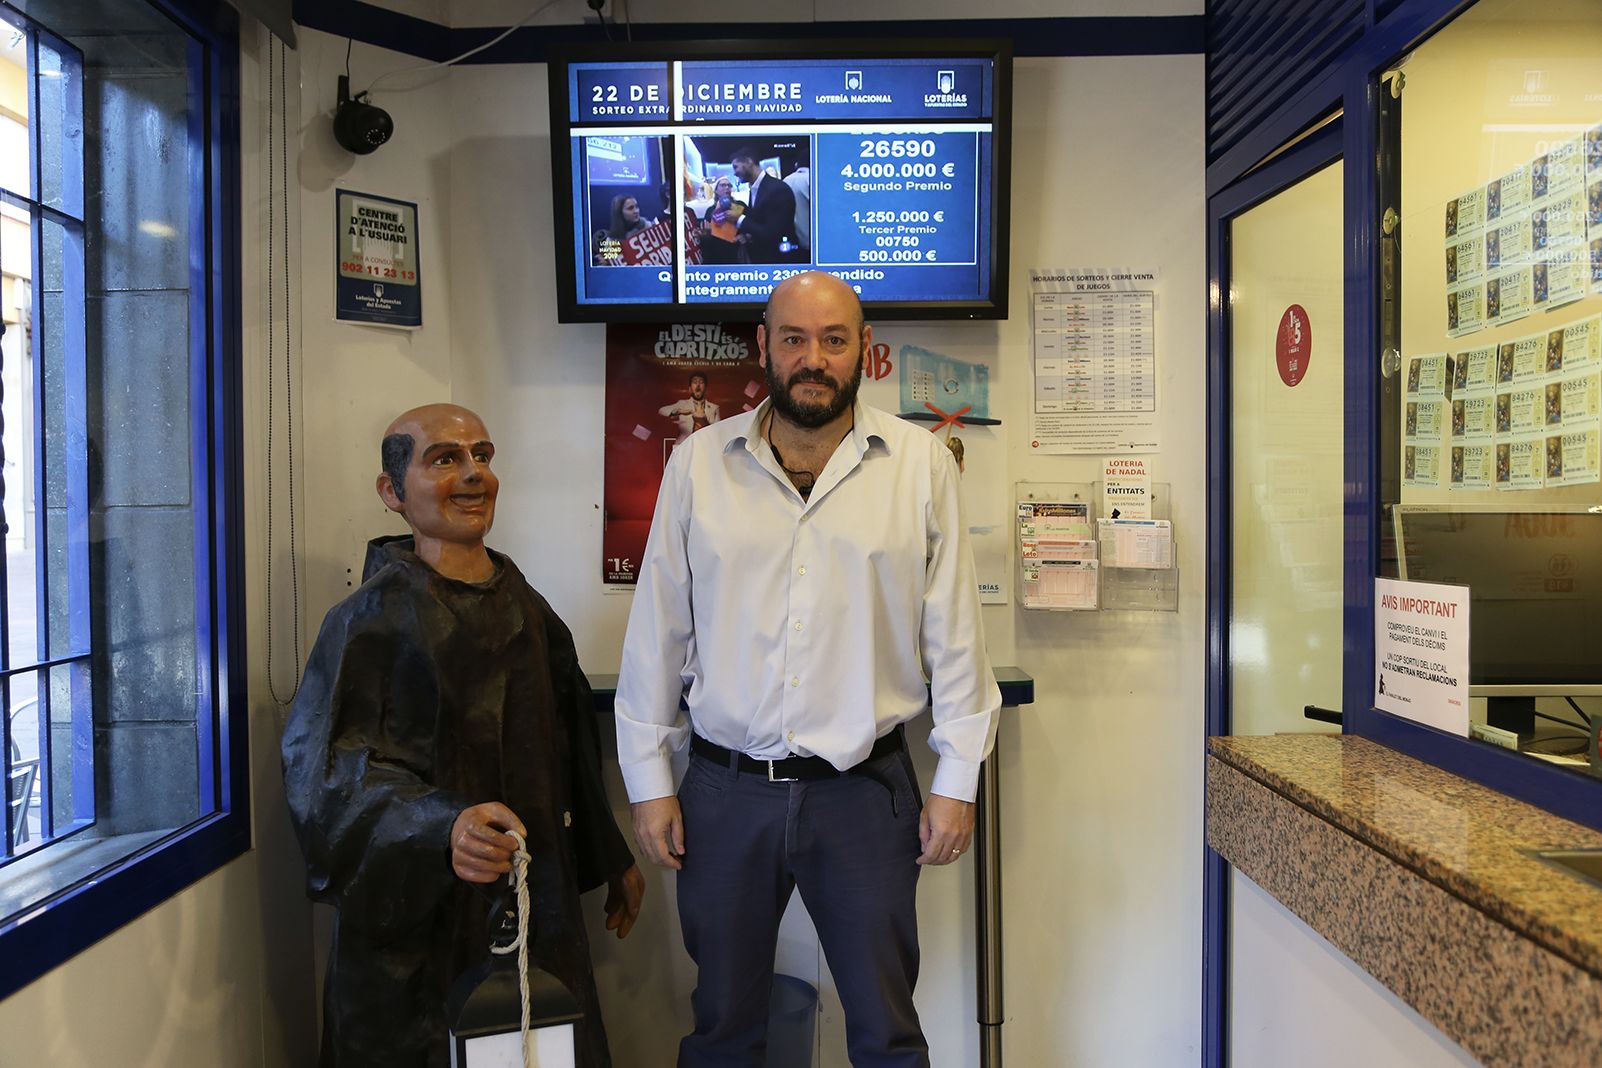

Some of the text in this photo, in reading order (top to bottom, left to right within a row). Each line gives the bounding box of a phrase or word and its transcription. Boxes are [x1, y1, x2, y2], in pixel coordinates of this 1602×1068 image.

[592, 83, 802, 102] 22 DE ICIEMBRE
[816, 94, 892, 103] LOTERÍA NACIONAL
[924, 93, 968, 102] LOTERÍAS
[592, 106, 634, 114] SORTEO
[738, 104, 751, 113] DE
[754, 104, 803, 112] NAVIDAD
[860, 140, 936, 158] 26590
[840, 162, 955, 178] 4.000.000 €
[844, 181, 952, 192] Segundo Premio
[358, 207, 398, 222] CENTRE
[852, 210, 944, 223] 1.250.000 €
[350, 216, 406, 234] D'ATENCIÓ
[858, 225, 937, 234] Tercer Premio
[348, 226, 408, 244] A L'USUARI
[876, 236, 920, 246] 00750
[858, 250, 937, 262] 500.000 €
[342, 261, 415, 280] 902 11 23 13
[658, 271, 710, 282] Qnto
[715, 270, 768, 283] premio
[828, 269, 884, 280] endido
[686, 284, 774, 297] ntegrament
[659, 322, 733, 344] EL DESTÍ ÉS
[1381, 594, 1457, 618] AVIS IMPORTANT
[1387, 622, 1414, 634] COMPROVEU
[1415, 627, 1420, 636] EL
[1421, 628, 1437, 638] CANVI
[1441, 631, 1448, 640] EL
[1389, 632, 1412, 643] PAGAMENT
[1412, 637, 1424, 647] DELS
[1387, 652, 1448, 674] UN COP SORTIU DEL LOCAL
[1382, 661, 1388, 670] NO
[1416, 670, 1458, 687] RECLAMACIONS
